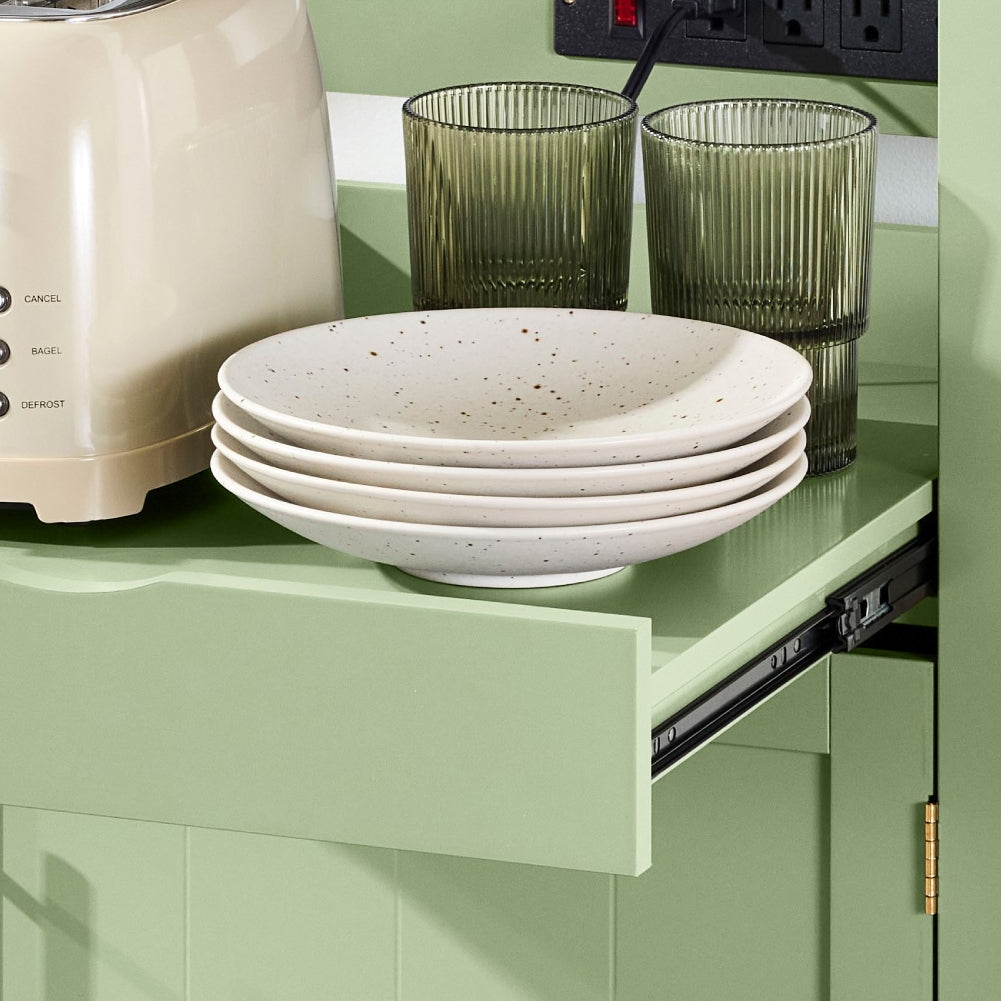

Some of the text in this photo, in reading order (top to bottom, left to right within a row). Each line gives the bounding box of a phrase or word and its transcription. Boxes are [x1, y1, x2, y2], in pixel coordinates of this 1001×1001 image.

[24, 294, 62, 304] CANCEL
[31, 346, 63, 356] BAGEL
[21, 399, 66, 409] DEFROST
